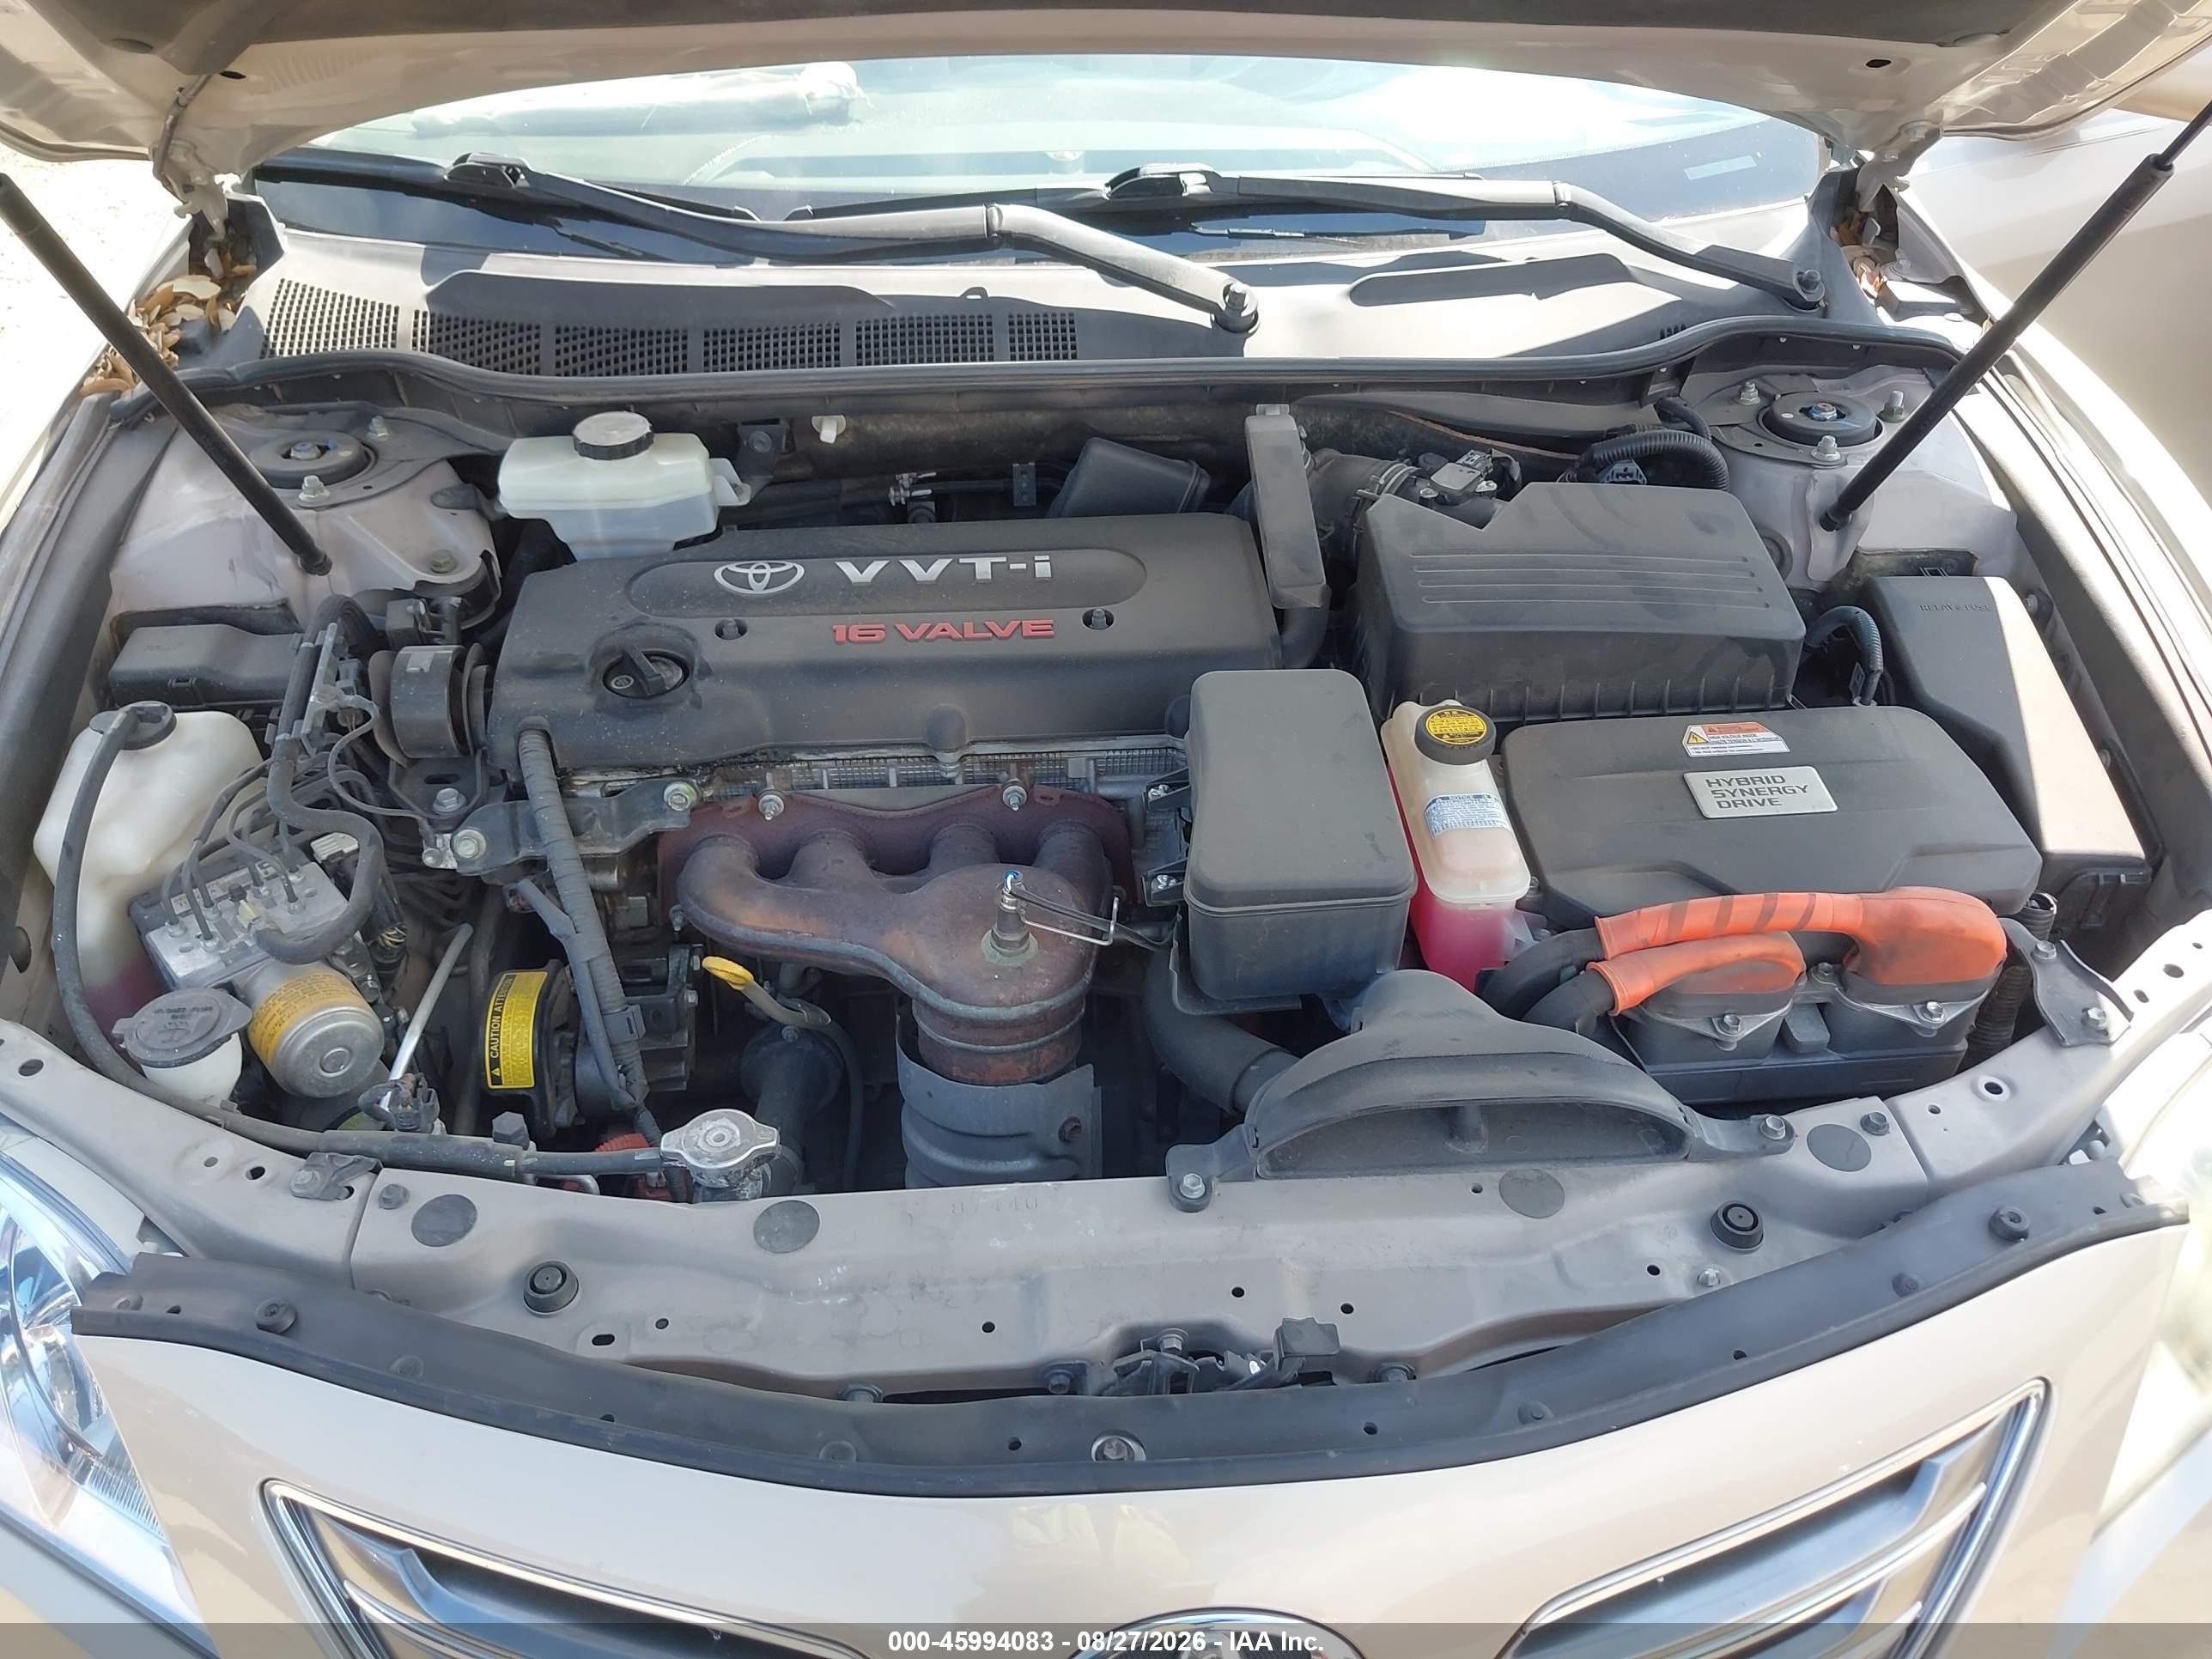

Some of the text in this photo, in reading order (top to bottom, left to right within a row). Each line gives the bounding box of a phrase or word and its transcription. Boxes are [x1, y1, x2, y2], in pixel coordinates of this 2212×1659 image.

[835, 556, 1052, 584] VVT-i
[832, 619, 1055, 643] 16 VALVE
[1705, 775, 1785, 787] HYBRID
[1711, 785, 1808, 799] SYNERGY
[1717, 797, 1782, 809] DRIVE
[489, 1015, 501, 1059] CAUTION
